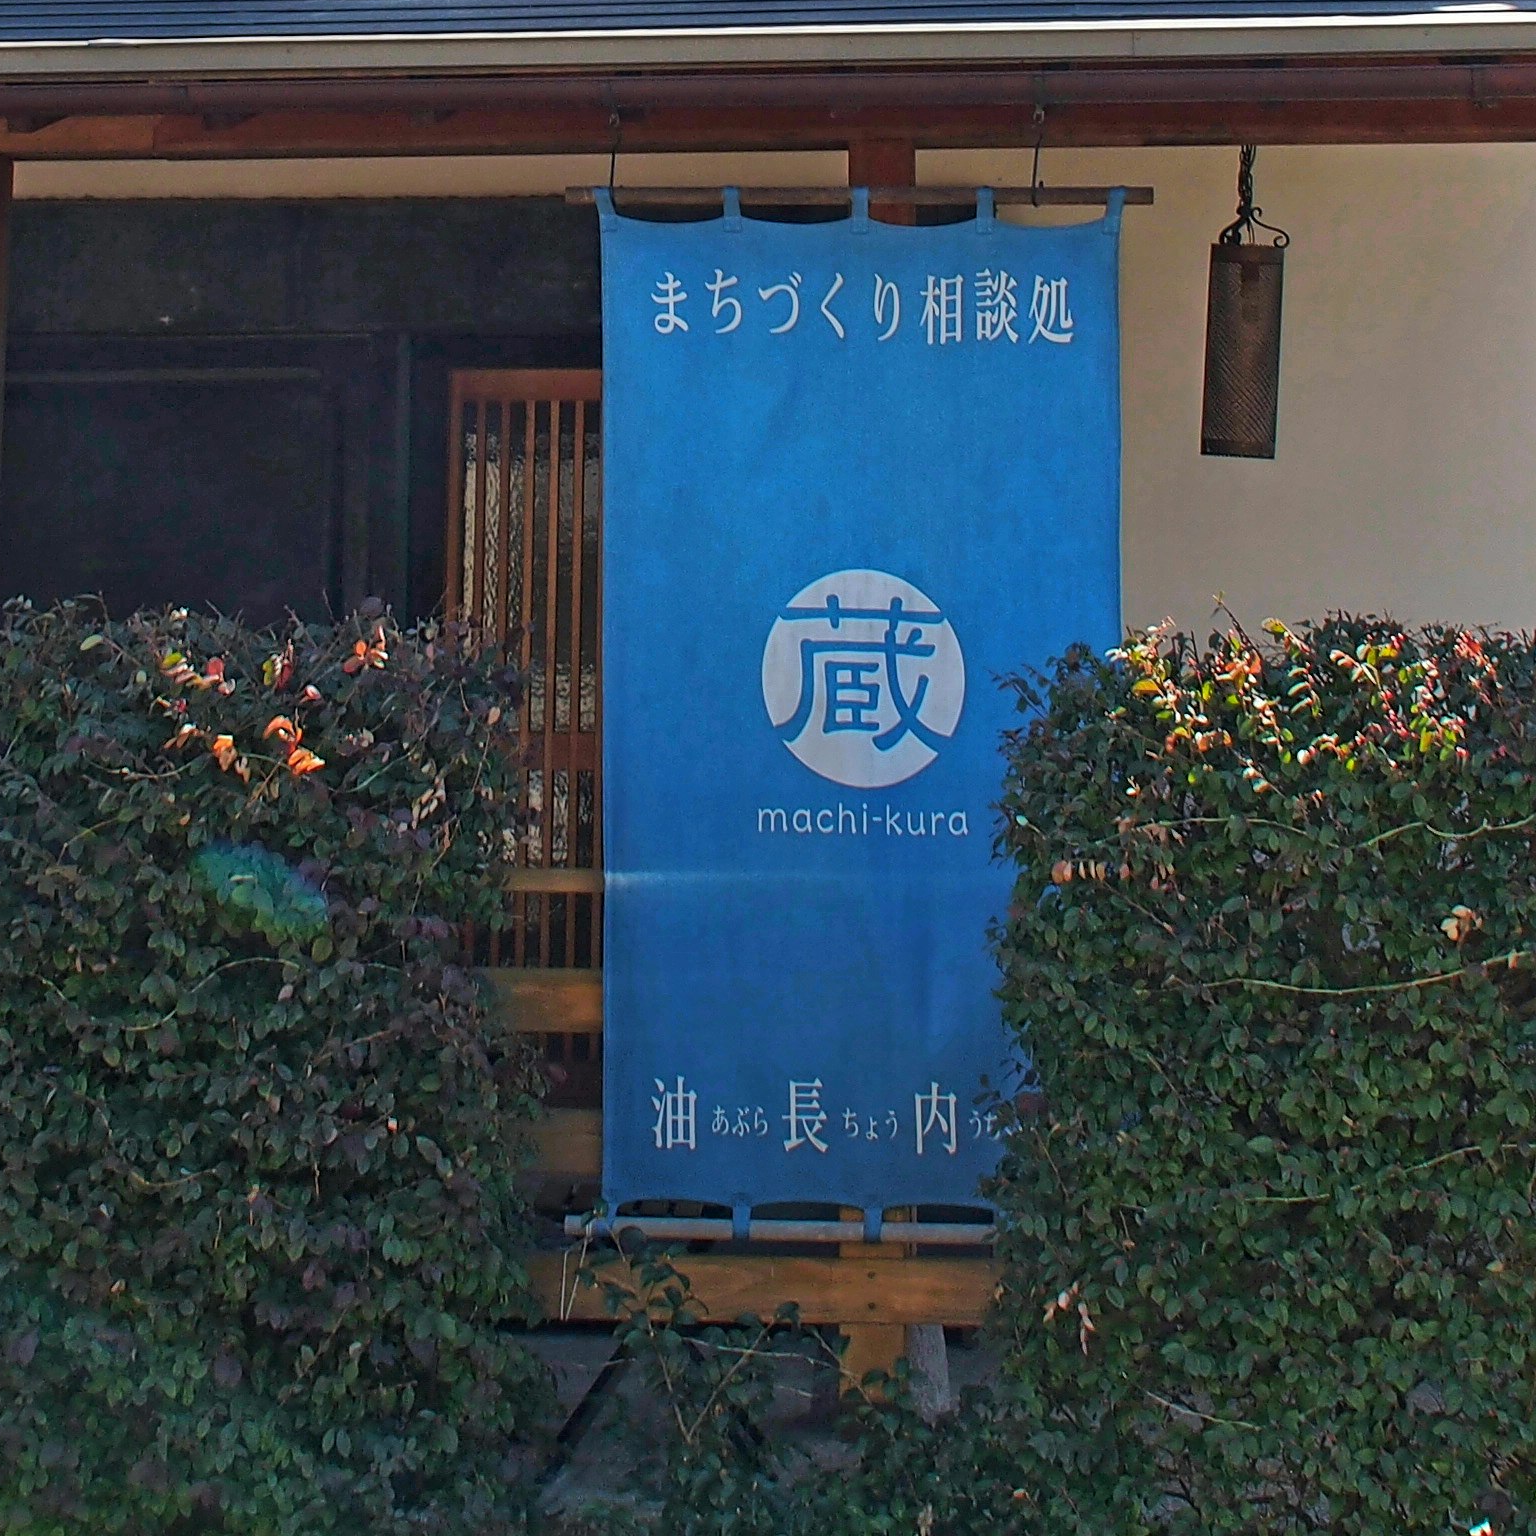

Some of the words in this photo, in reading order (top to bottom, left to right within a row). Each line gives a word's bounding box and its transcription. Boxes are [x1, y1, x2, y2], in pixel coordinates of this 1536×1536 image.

[650, 265, 1075, 346] まちづくり相談処
[770, 592, 950, 758] 蔵
[757, 802, 969, 837] machi-kura
